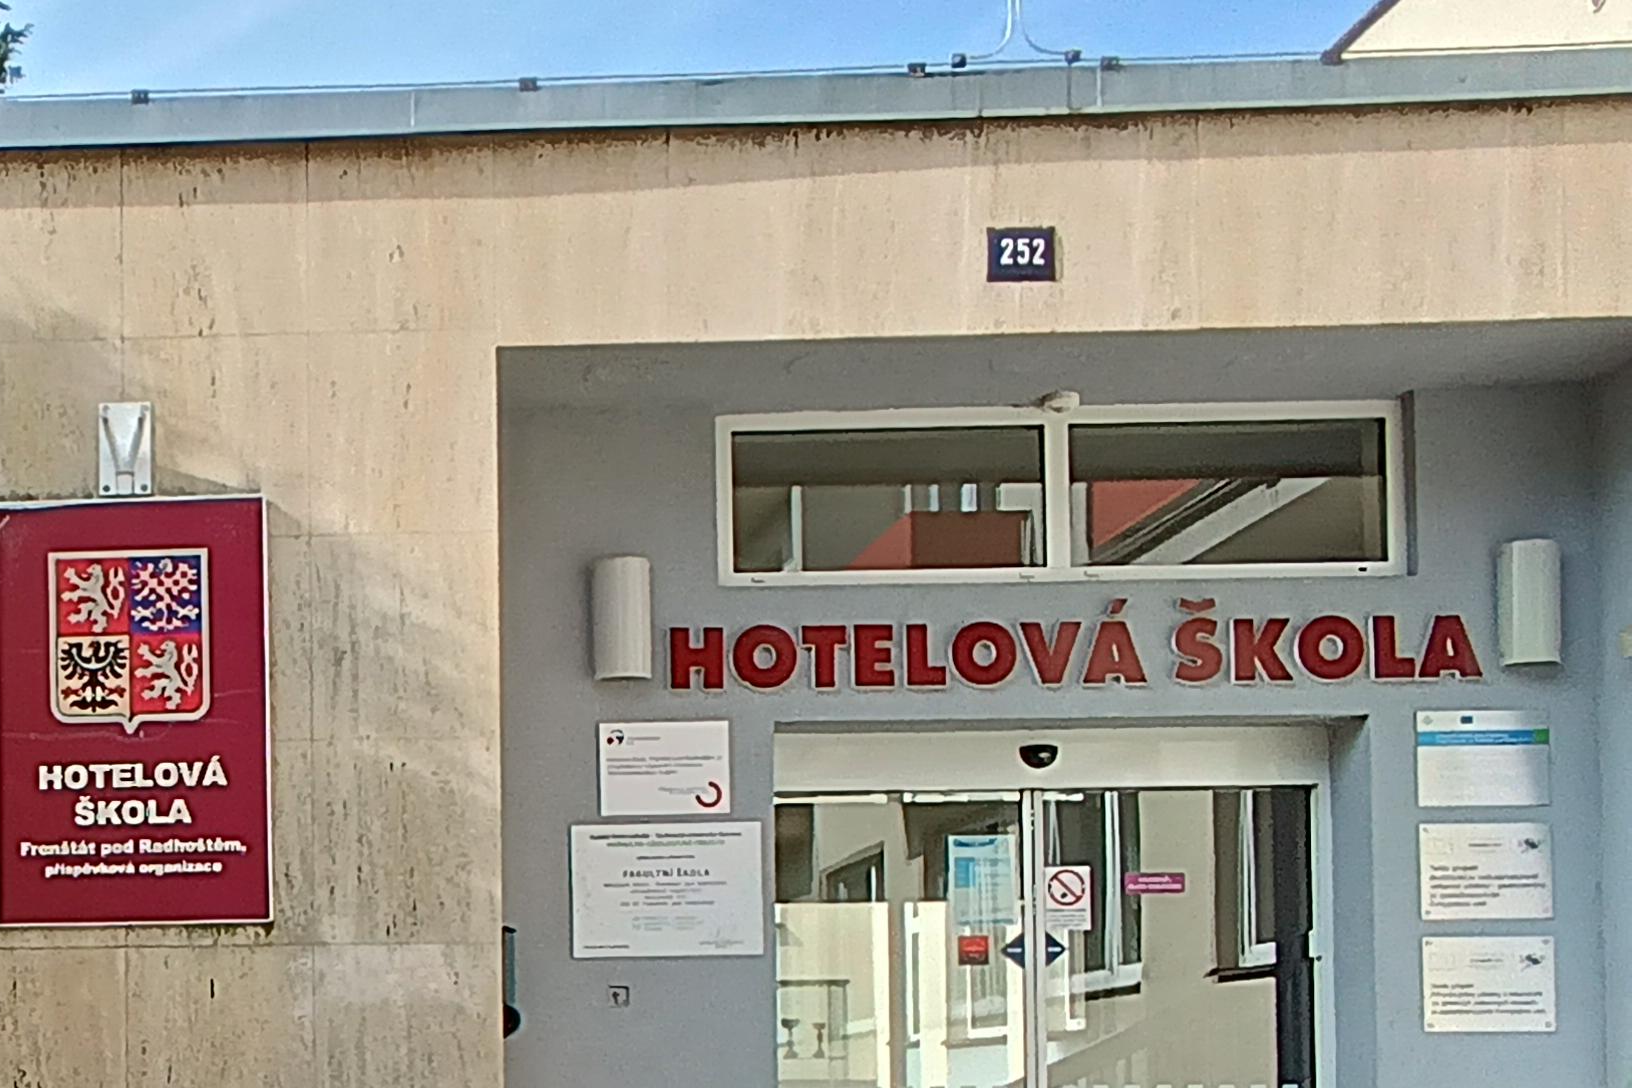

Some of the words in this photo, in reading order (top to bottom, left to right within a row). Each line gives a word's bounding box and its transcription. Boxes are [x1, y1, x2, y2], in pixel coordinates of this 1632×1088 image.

[999, 237, 1046, 266] 252
[668, 597, 1148, 691] HOTELOVÁ
[1171, 597, 1484, 685] ŠKOLA
[38, 755, 228, 790] HOTELOVÁ
[74, 796, 193, 826] ŠKOLA
[100, 839, 134, 857] pod
[139, 860, 223, 876] organizace
